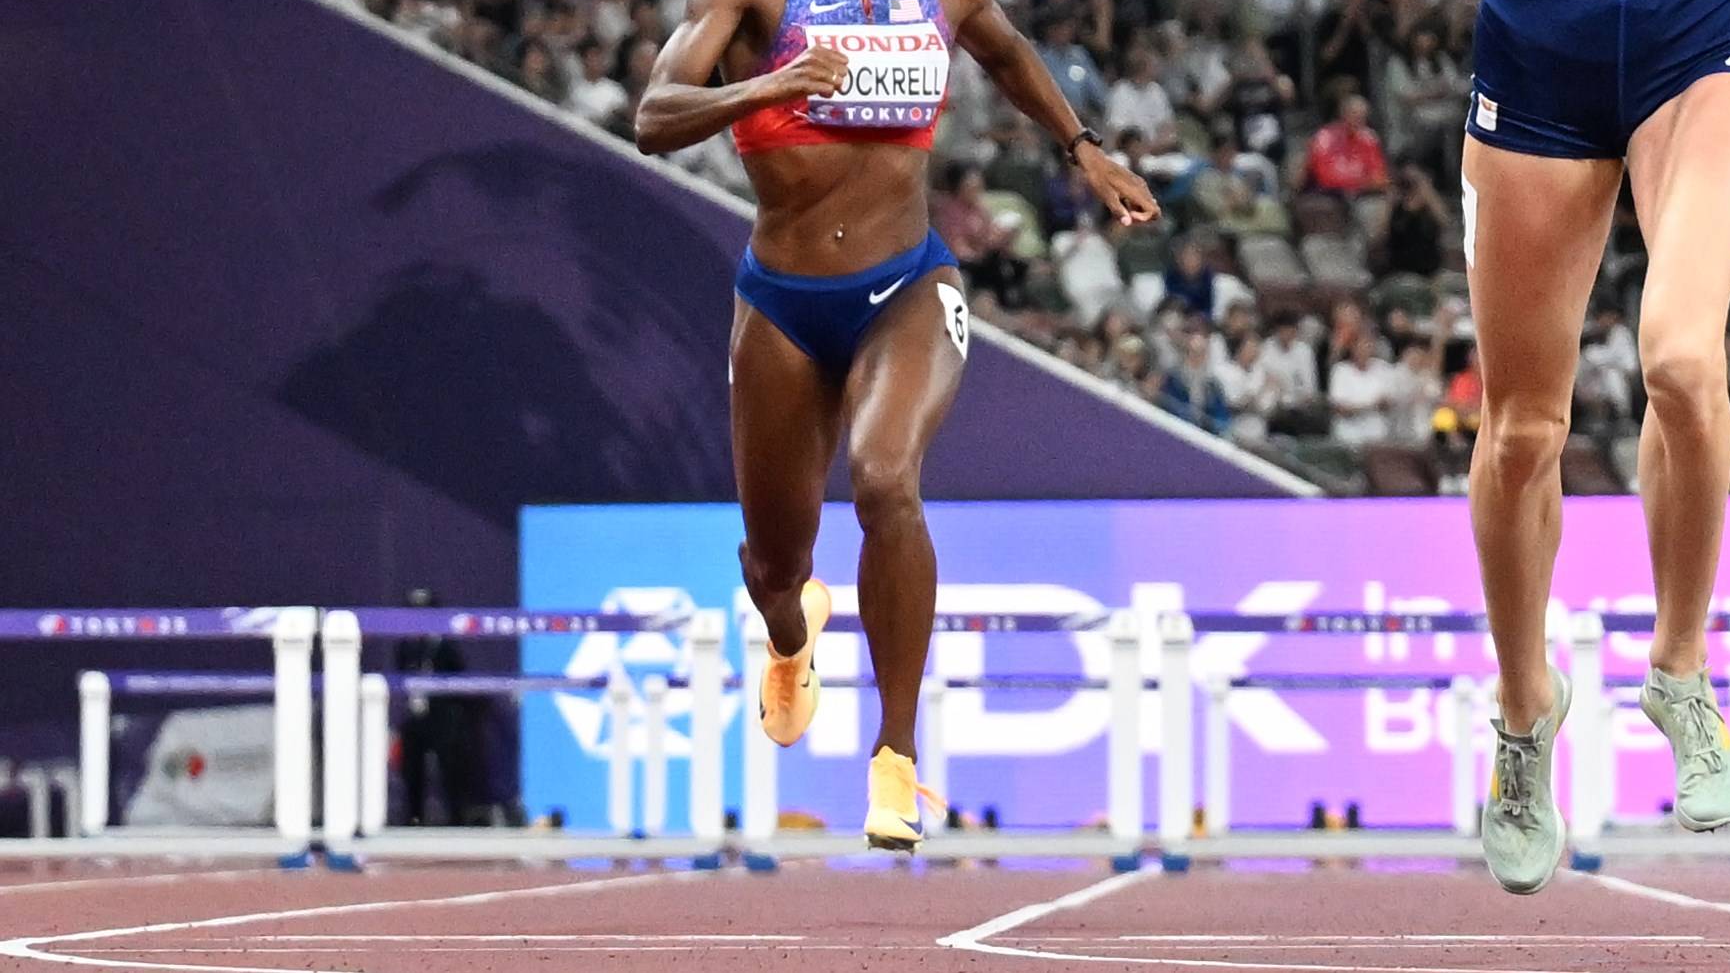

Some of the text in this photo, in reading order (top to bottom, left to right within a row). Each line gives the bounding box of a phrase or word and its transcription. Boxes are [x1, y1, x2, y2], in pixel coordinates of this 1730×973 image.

[812, 34, 945, 52] HONDA
[836, 65, 941, 96] OCKRELL
[953, 304, 965, 344] 6
